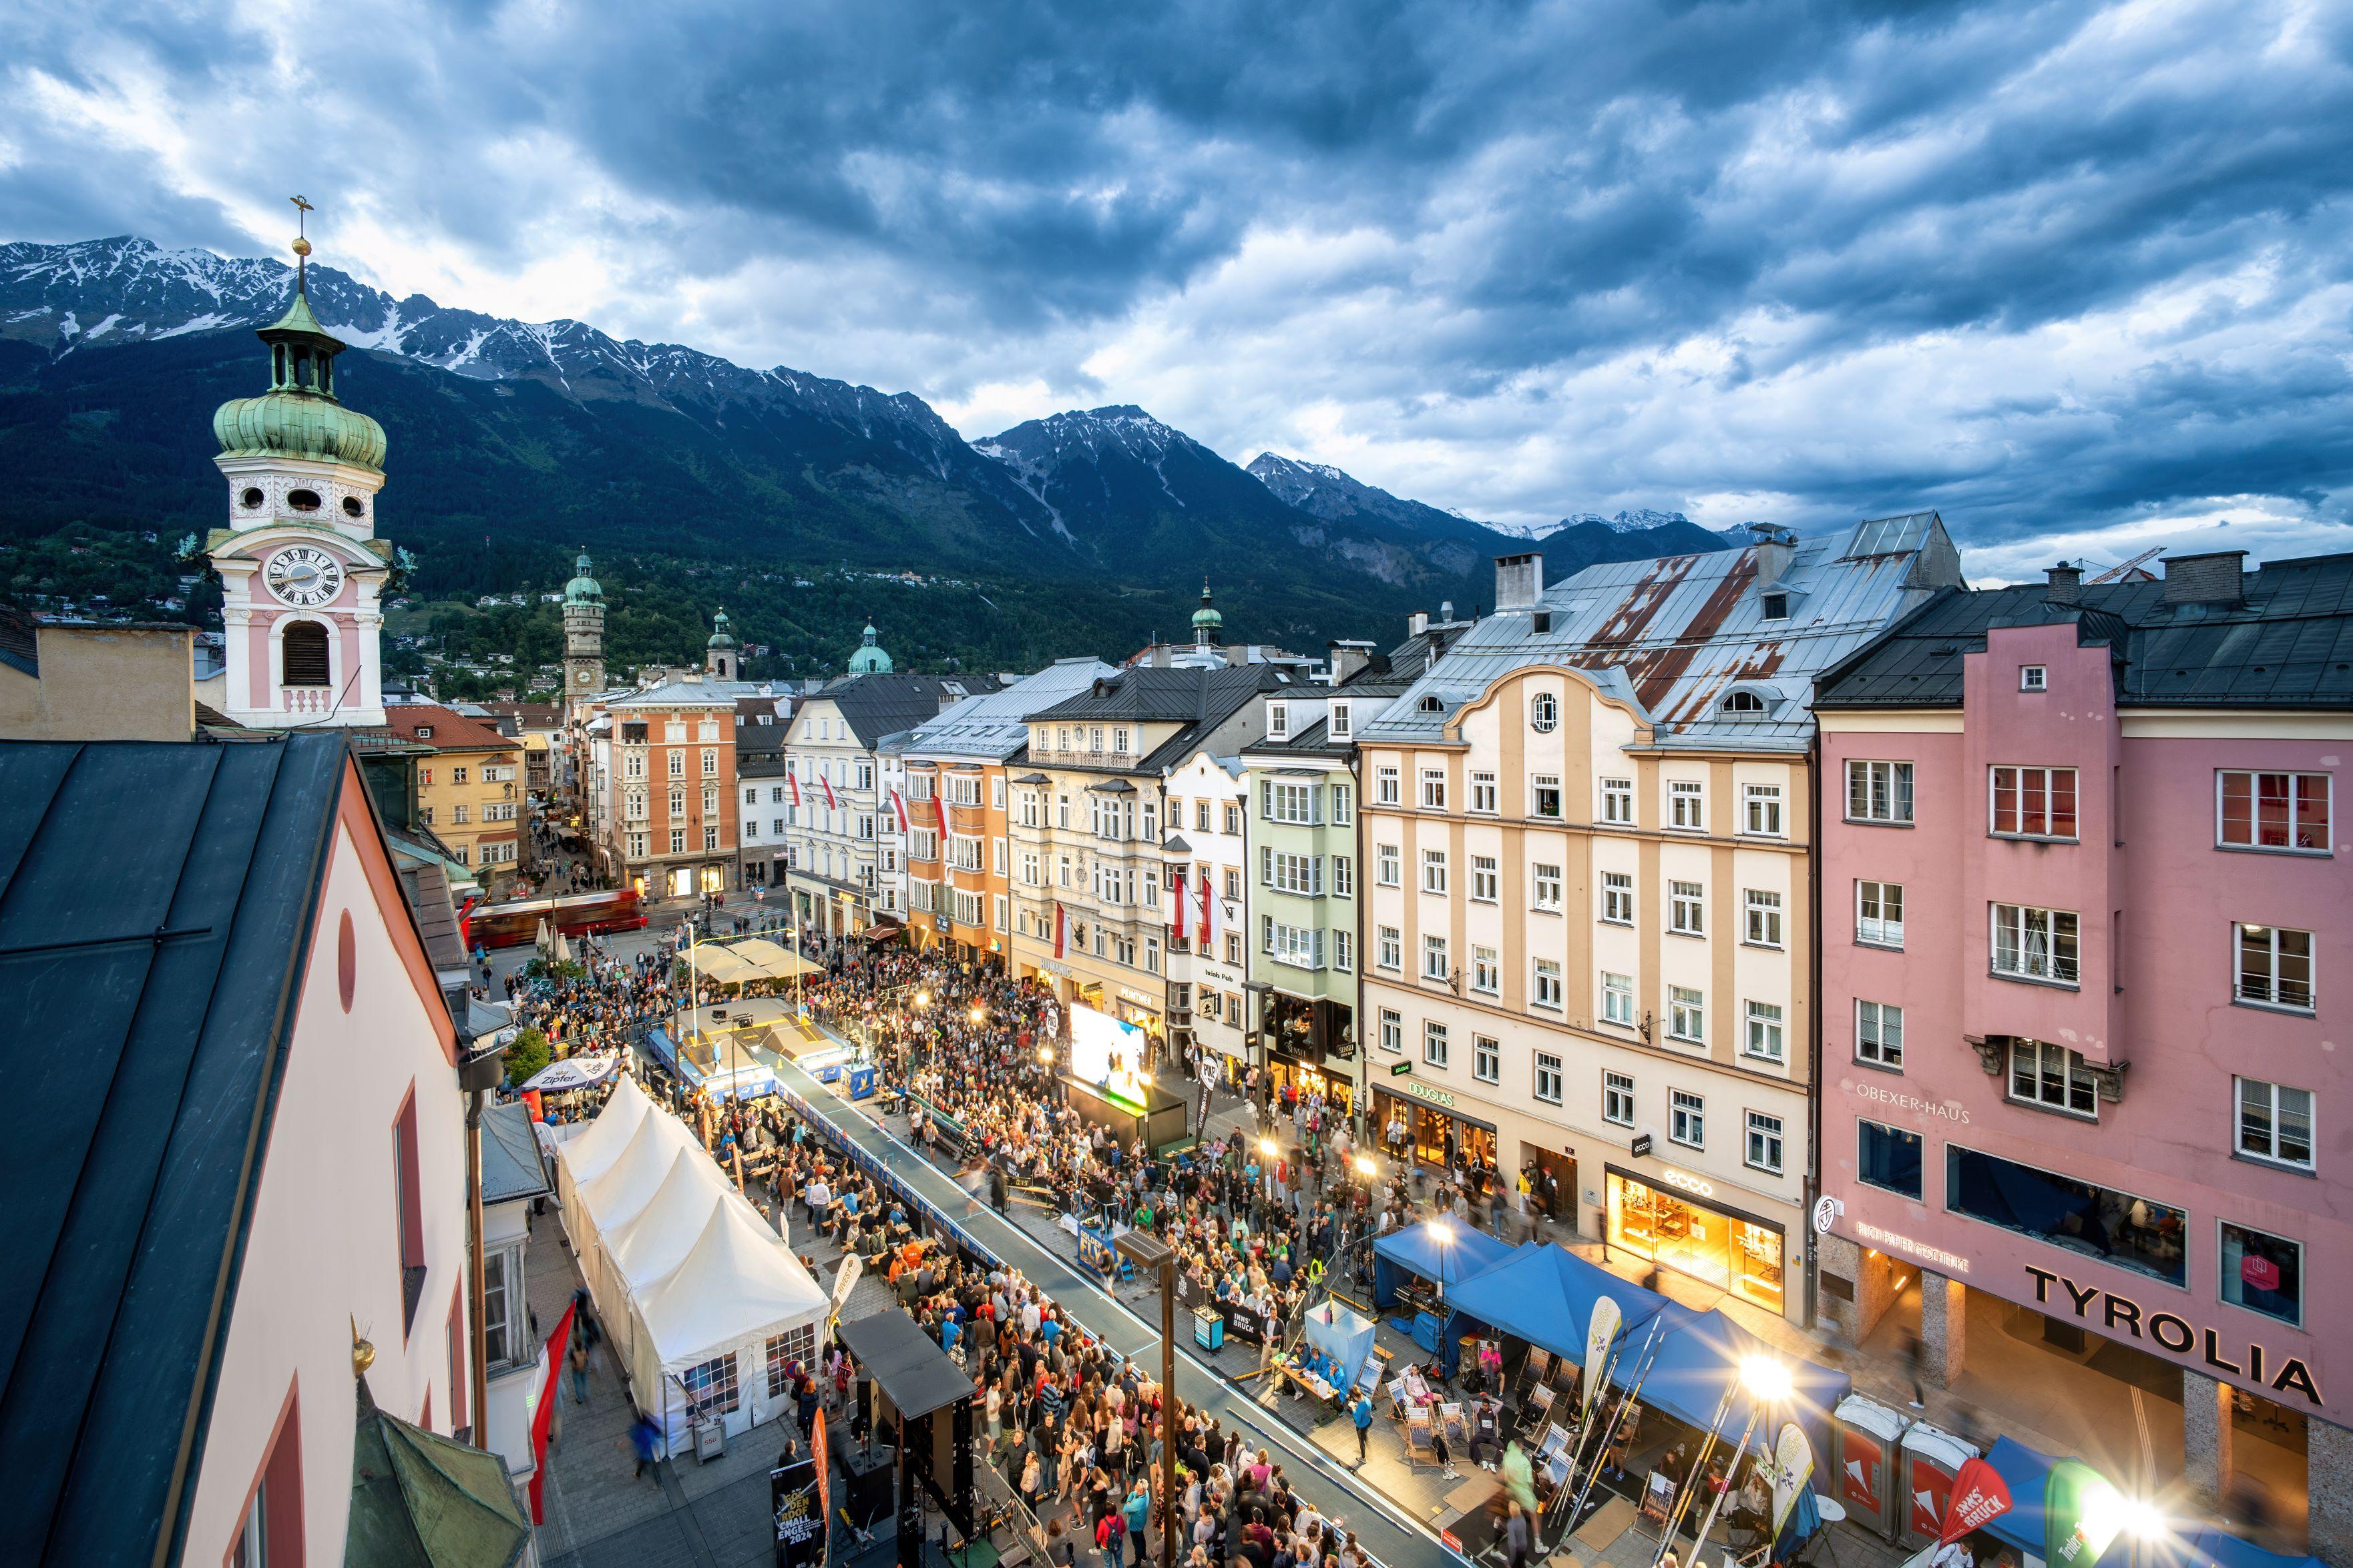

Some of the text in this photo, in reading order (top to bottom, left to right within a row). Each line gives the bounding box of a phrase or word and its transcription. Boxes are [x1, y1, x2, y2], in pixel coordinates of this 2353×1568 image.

[282, 551, 295, 563] XI
[298, 549, 309, 560] XII
[314, 554, 322, 563] I
[272, 560, 286, 569] X
[323, 563, 335, 571] II
[326, 574, 338, 583] III
[284, 590, 296, 601] VII
[321, 583, 336, 596] IIII
[301, 593, 309, 604] VI
[315, 592, 325, 602] V
[1040, 959, 1072, 978] HUMANIC
[1205, 969, 1233, 983] Irish Pub
[1339, 1044, 1353, 1053] SENSEI
[586, 1062, 606, 1075] Zipfer
[1396, 1065, 1409, 1074] DOUGLAS
[541, 1075, 577, 1085] Zipfer
[1409, 1081, 1454, 1107] DOUGLAS
[1857, 1084, 1970, 1124] OBEXER-HAUS
[1635, 1141, 1650, 1152] ecco
[1664, 1169, 1713, 1196] ecco
[1080, 1230, 1102, 1249] GOLDEN
[1080, 1236, 1101, 1263] FLY
[1858, 1222, 1969, 1273] BUCH PAPIER GESCHENKE
[837, 1268, 853, 1295] RIVEST
[1233, 1312, 1251, 1324] INNS'
[1233, 1319, 1254, 1334] BRUCK
[2025, 1265, 2324, 1406] TYROLIA
[1779, 1436, 1793, 1457] FOUR
[1781, 1432, 1801, 1464] SEASONS
[1786, 1443, 1803, 1467] TRAVEL
[1757, 1458, 1777, 1482] EXIT
[786, 1492, 803, 1503] GOL
[790, 1497, 809, 1510] DEN
[1956, 1485, 1983, 1518] INNS'
[781, 1506, 808, 1521] ROOF
[1963, 1495, 2006, 1528] BRUCK
[780, 1514, 811, 1530] CHALL
[778, 1524, 804, 1540] ENGE
[789, 1531, 813, 1545] 2024
[2059, 1533, 2083, 1562] Tiroler
